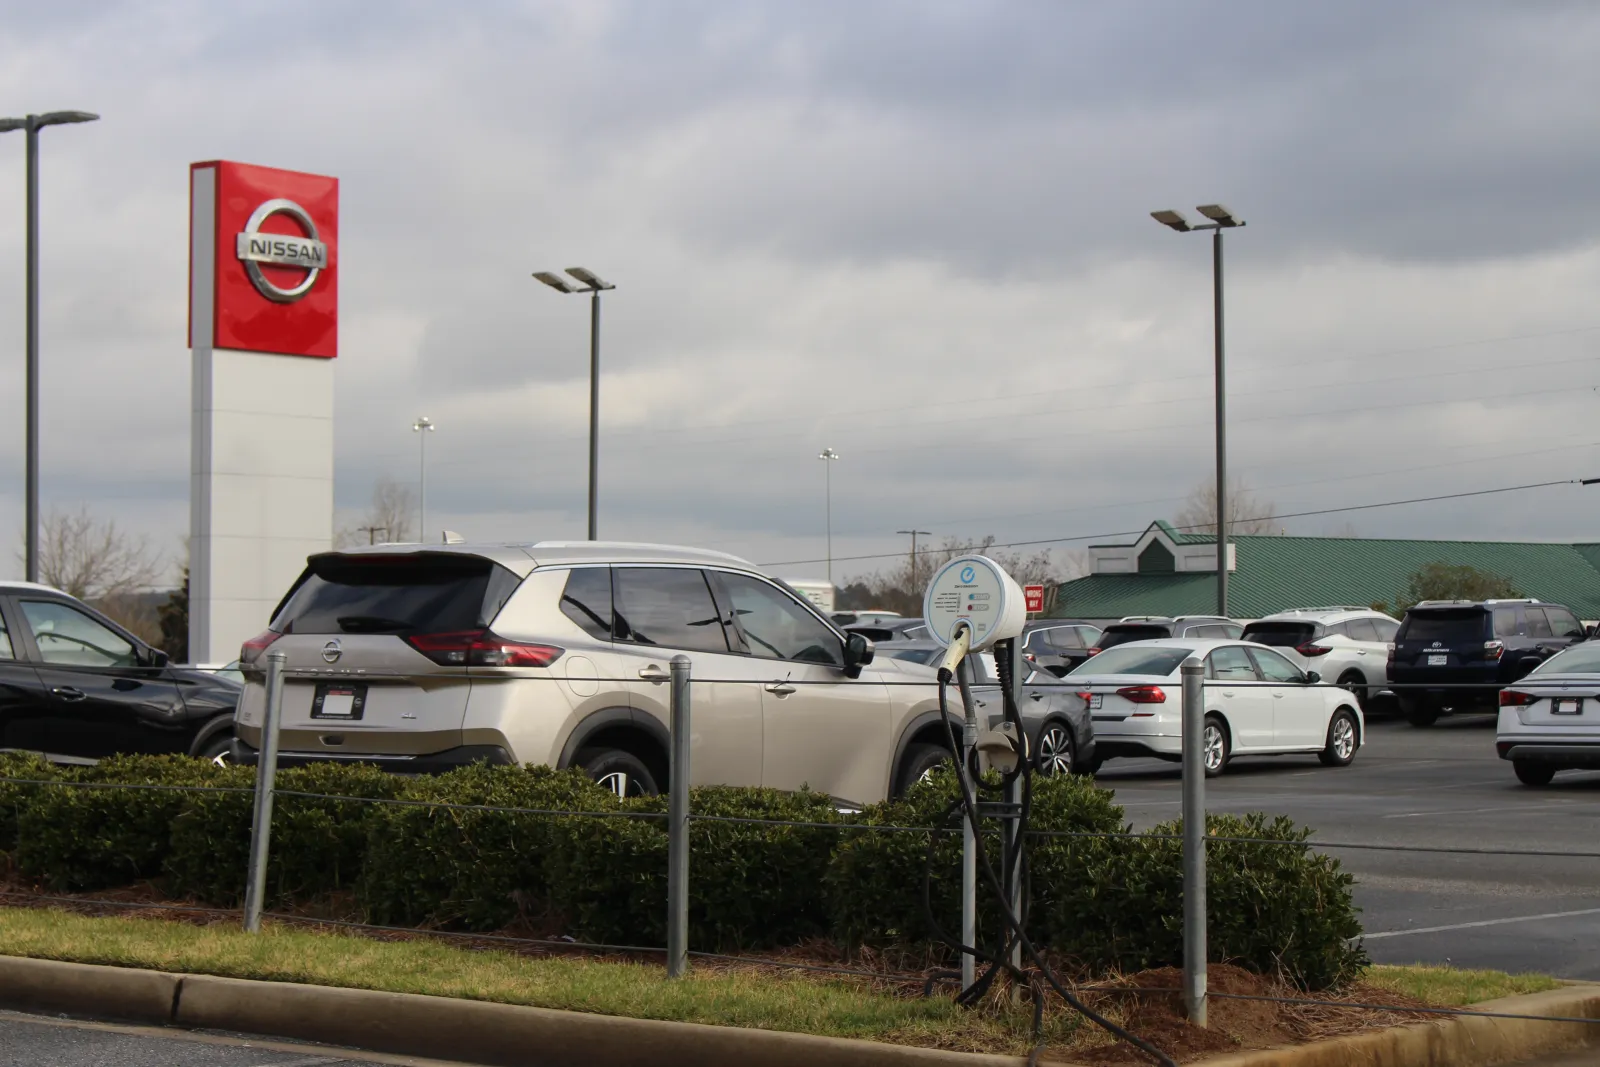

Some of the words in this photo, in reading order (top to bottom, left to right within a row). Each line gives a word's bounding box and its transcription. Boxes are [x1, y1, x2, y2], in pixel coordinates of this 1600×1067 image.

[250, 239, 322, 262] NISSAN
[1027, 589, 1042, 598] WRONG
[1029, 600, 1039, 608] WAY
